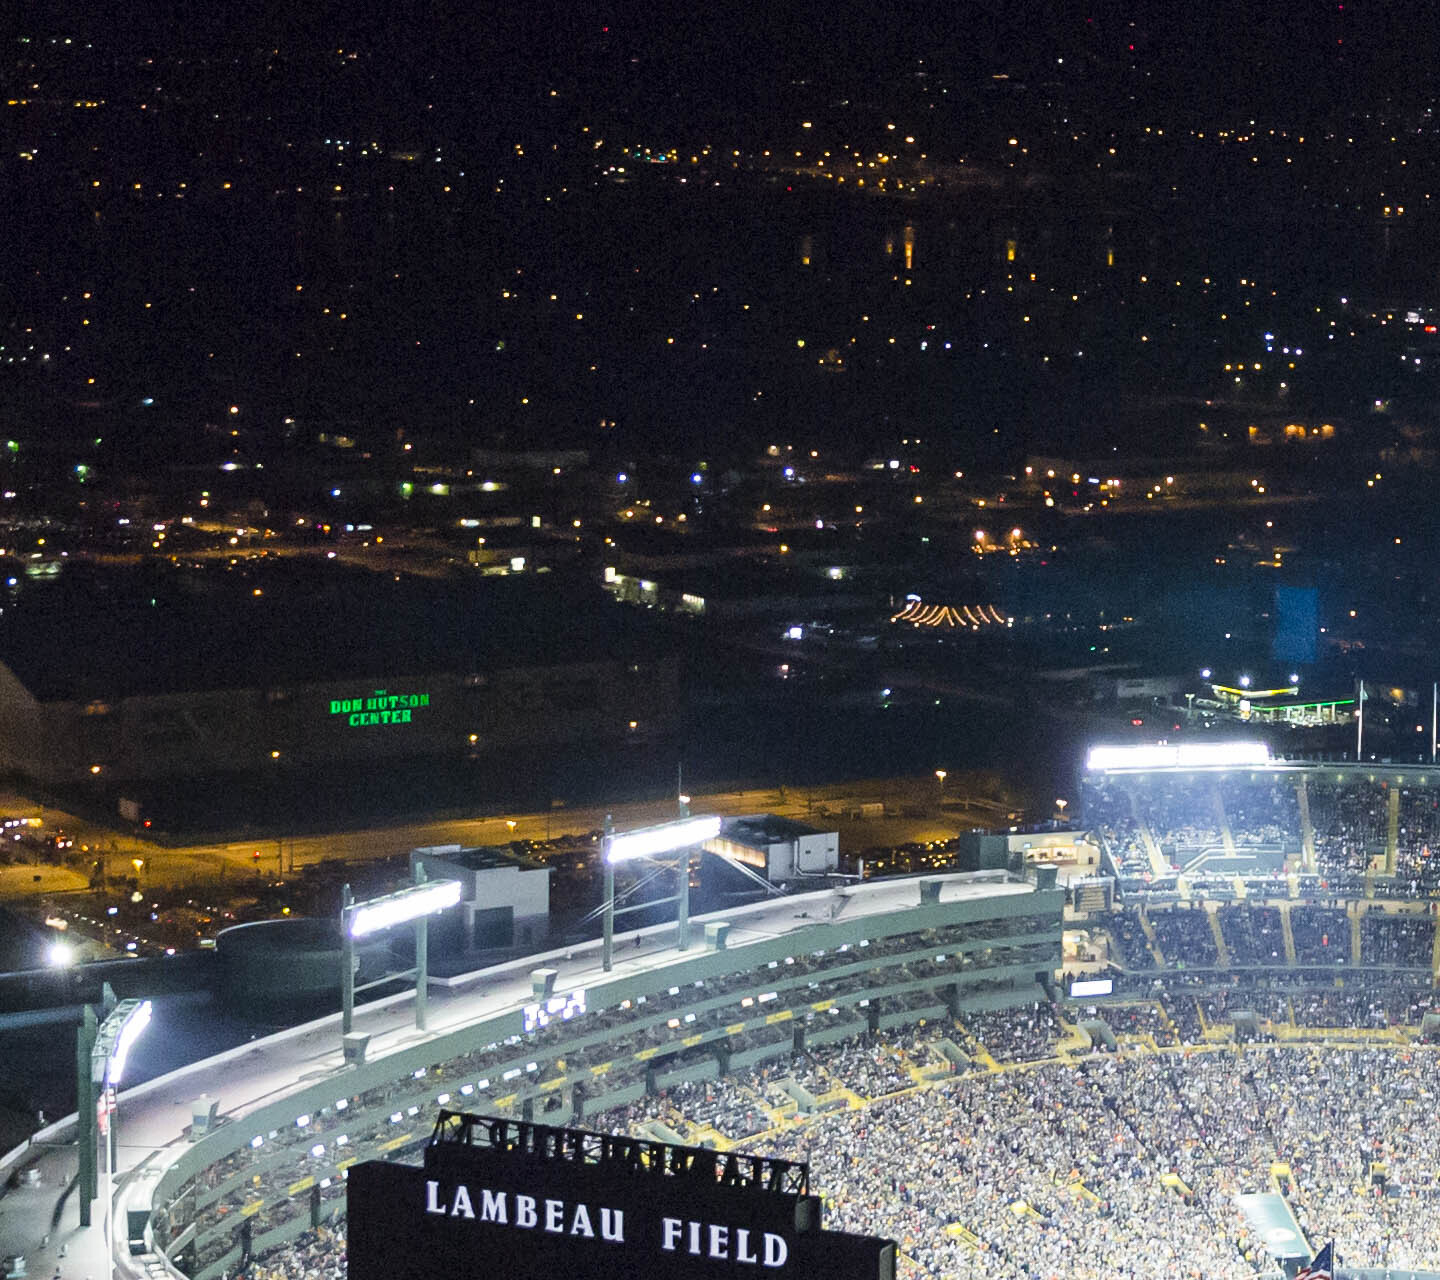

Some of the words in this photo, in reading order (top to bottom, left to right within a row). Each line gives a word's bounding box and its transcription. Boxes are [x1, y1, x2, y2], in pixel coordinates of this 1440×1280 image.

[330, 699, 362, 714] DON
[366, 694, 430, 710] HUTSON
[350, 709, 412, 726] CENTER
[425, 1179, 625, 1243] LAMBEAU
[661, 1217, 789, 1268] FIELD
